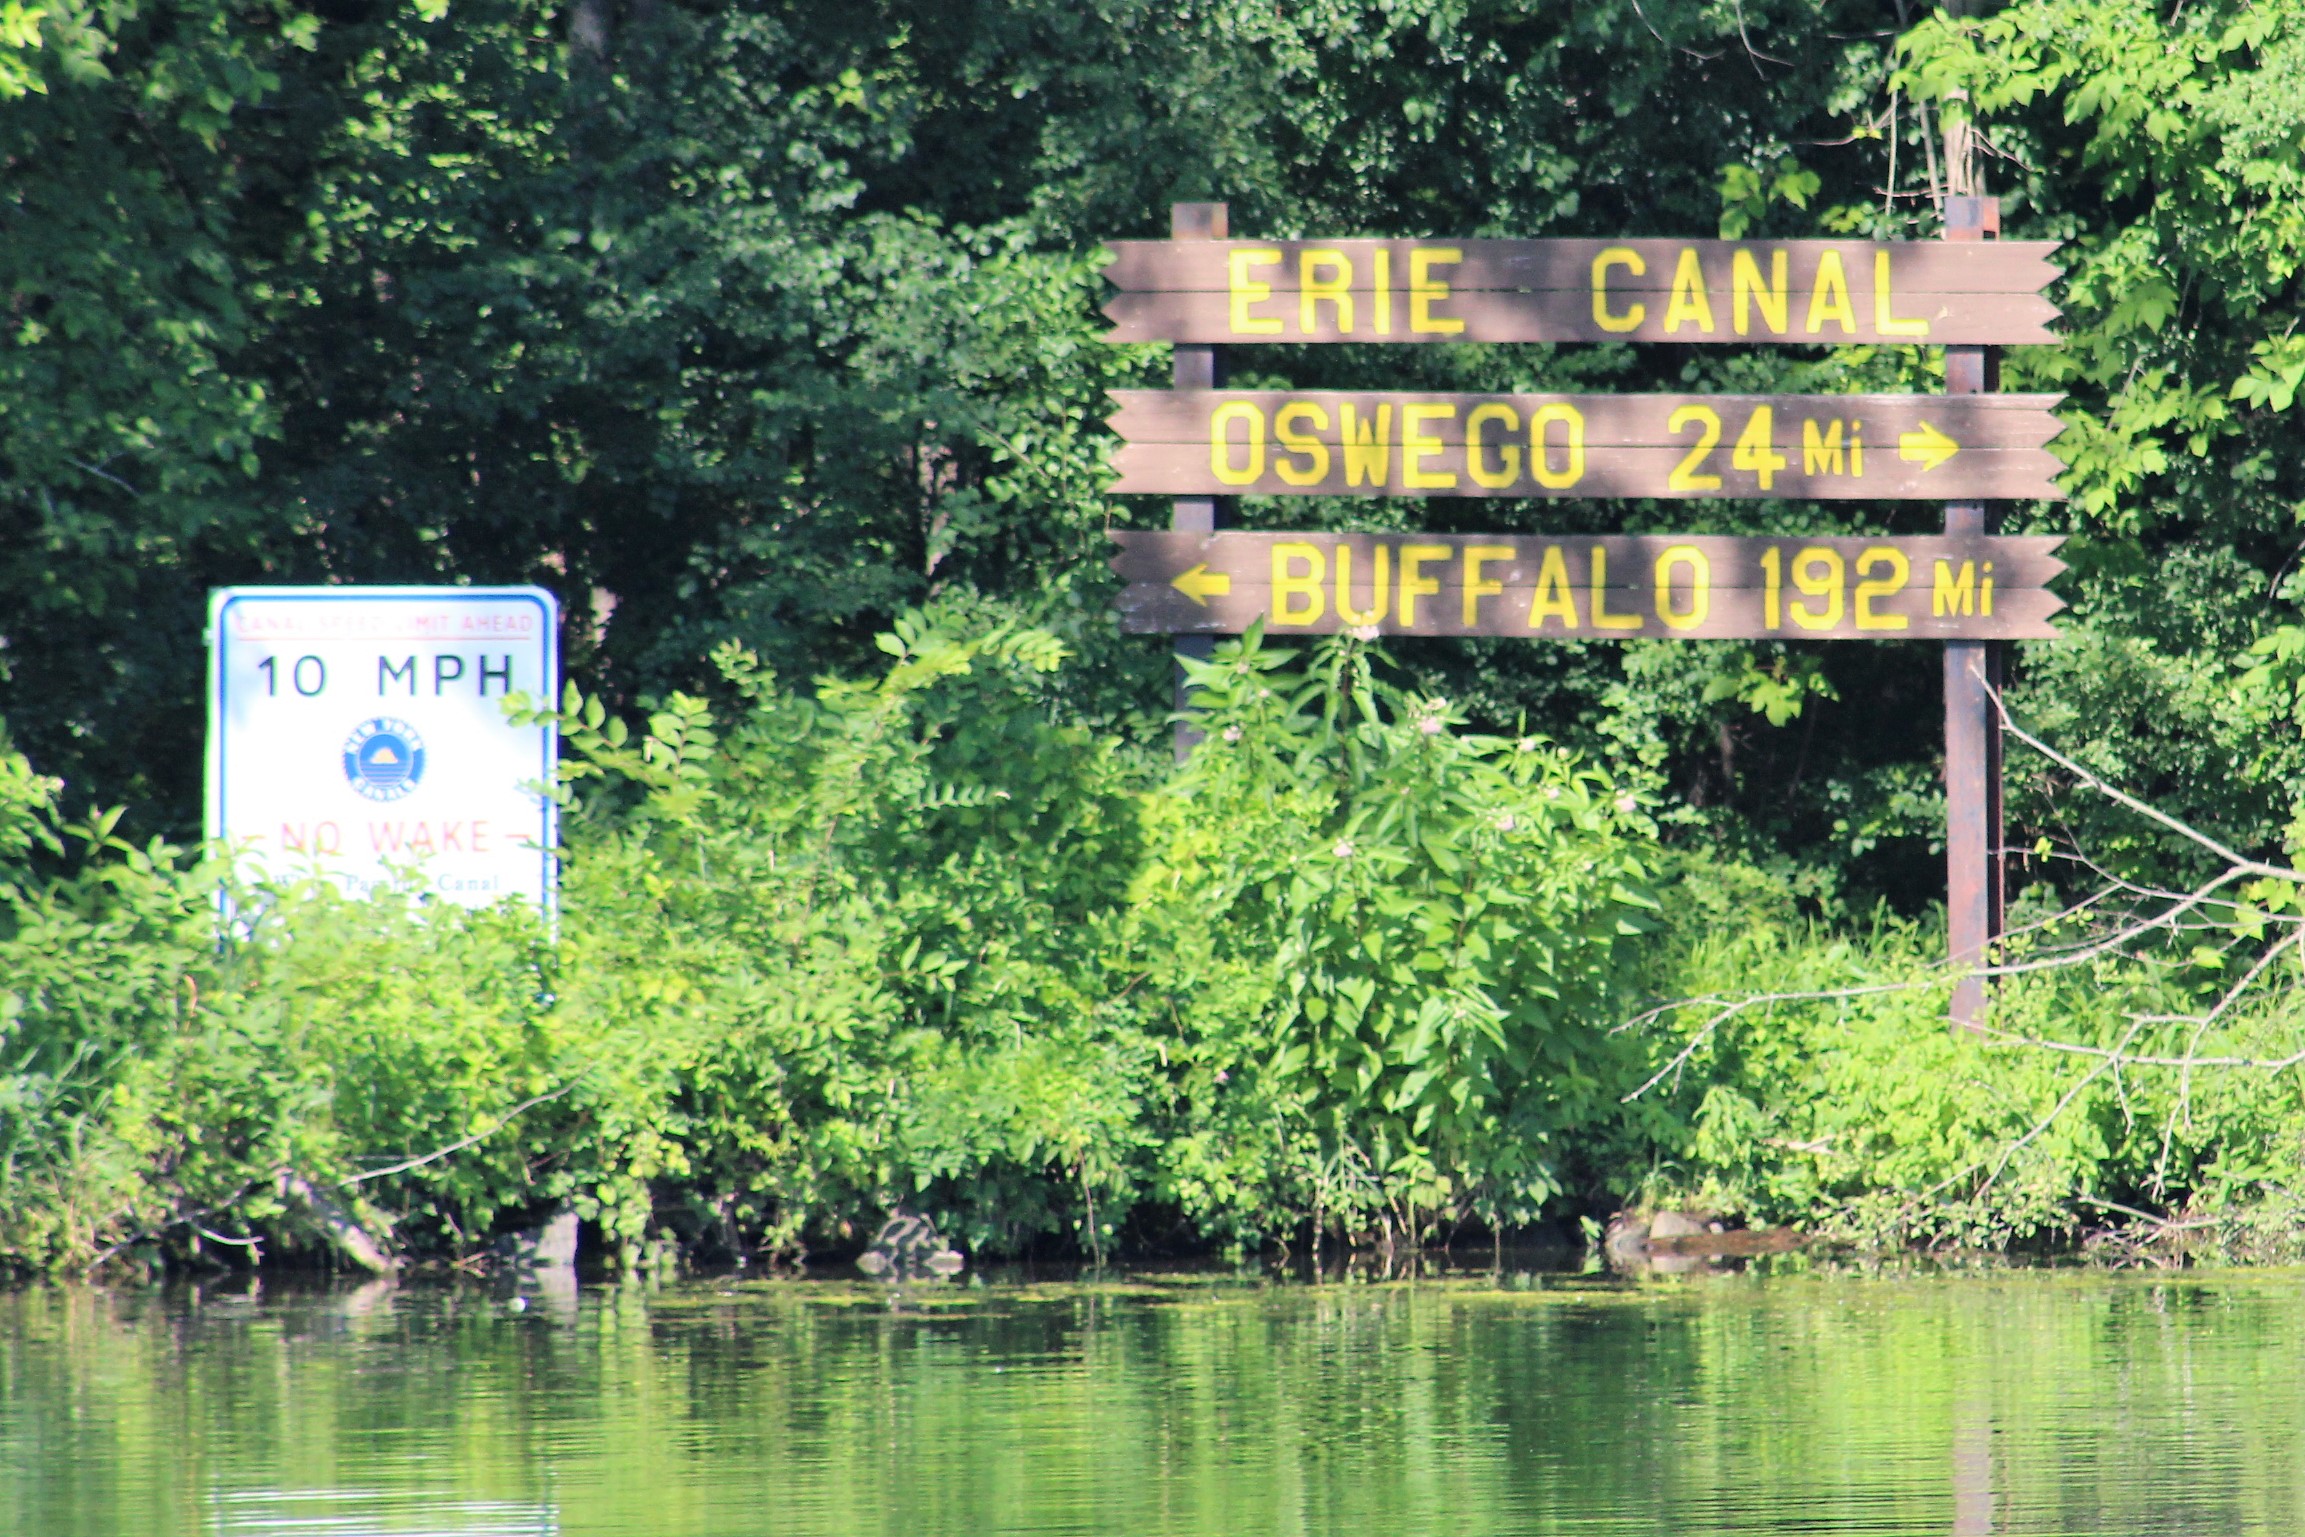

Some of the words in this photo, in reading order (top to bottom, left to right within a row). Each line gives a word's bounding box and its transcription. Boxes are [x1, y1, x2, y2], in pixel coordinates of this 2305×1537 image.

[1227, 247, 1466, 335] ERIE
[1591, 247, 1930, 337] CANAL
[1209, 399, 1587, 489] OSWEGO
[1667, 403, 1788, 492] 24
[1801, 418, 1864, 478] Mi
[1270, 541, 1711, 630] BUFFALO
[1760, 545, 1911, 631] 192
[1931, 559, 1994, 617] Mi
[236, 615, 304, 632] CANA
[394, 614, 449, 632] IMIT
[463, 614, 534, 632] AHEAD
[257, 654, 326, 697] 10
[377, 654, 514, 697] MPH
[280, 820, 341, 854] NO
[367, 820, 490, 853] WAKE
[437, 873, 500, 891] Canal
